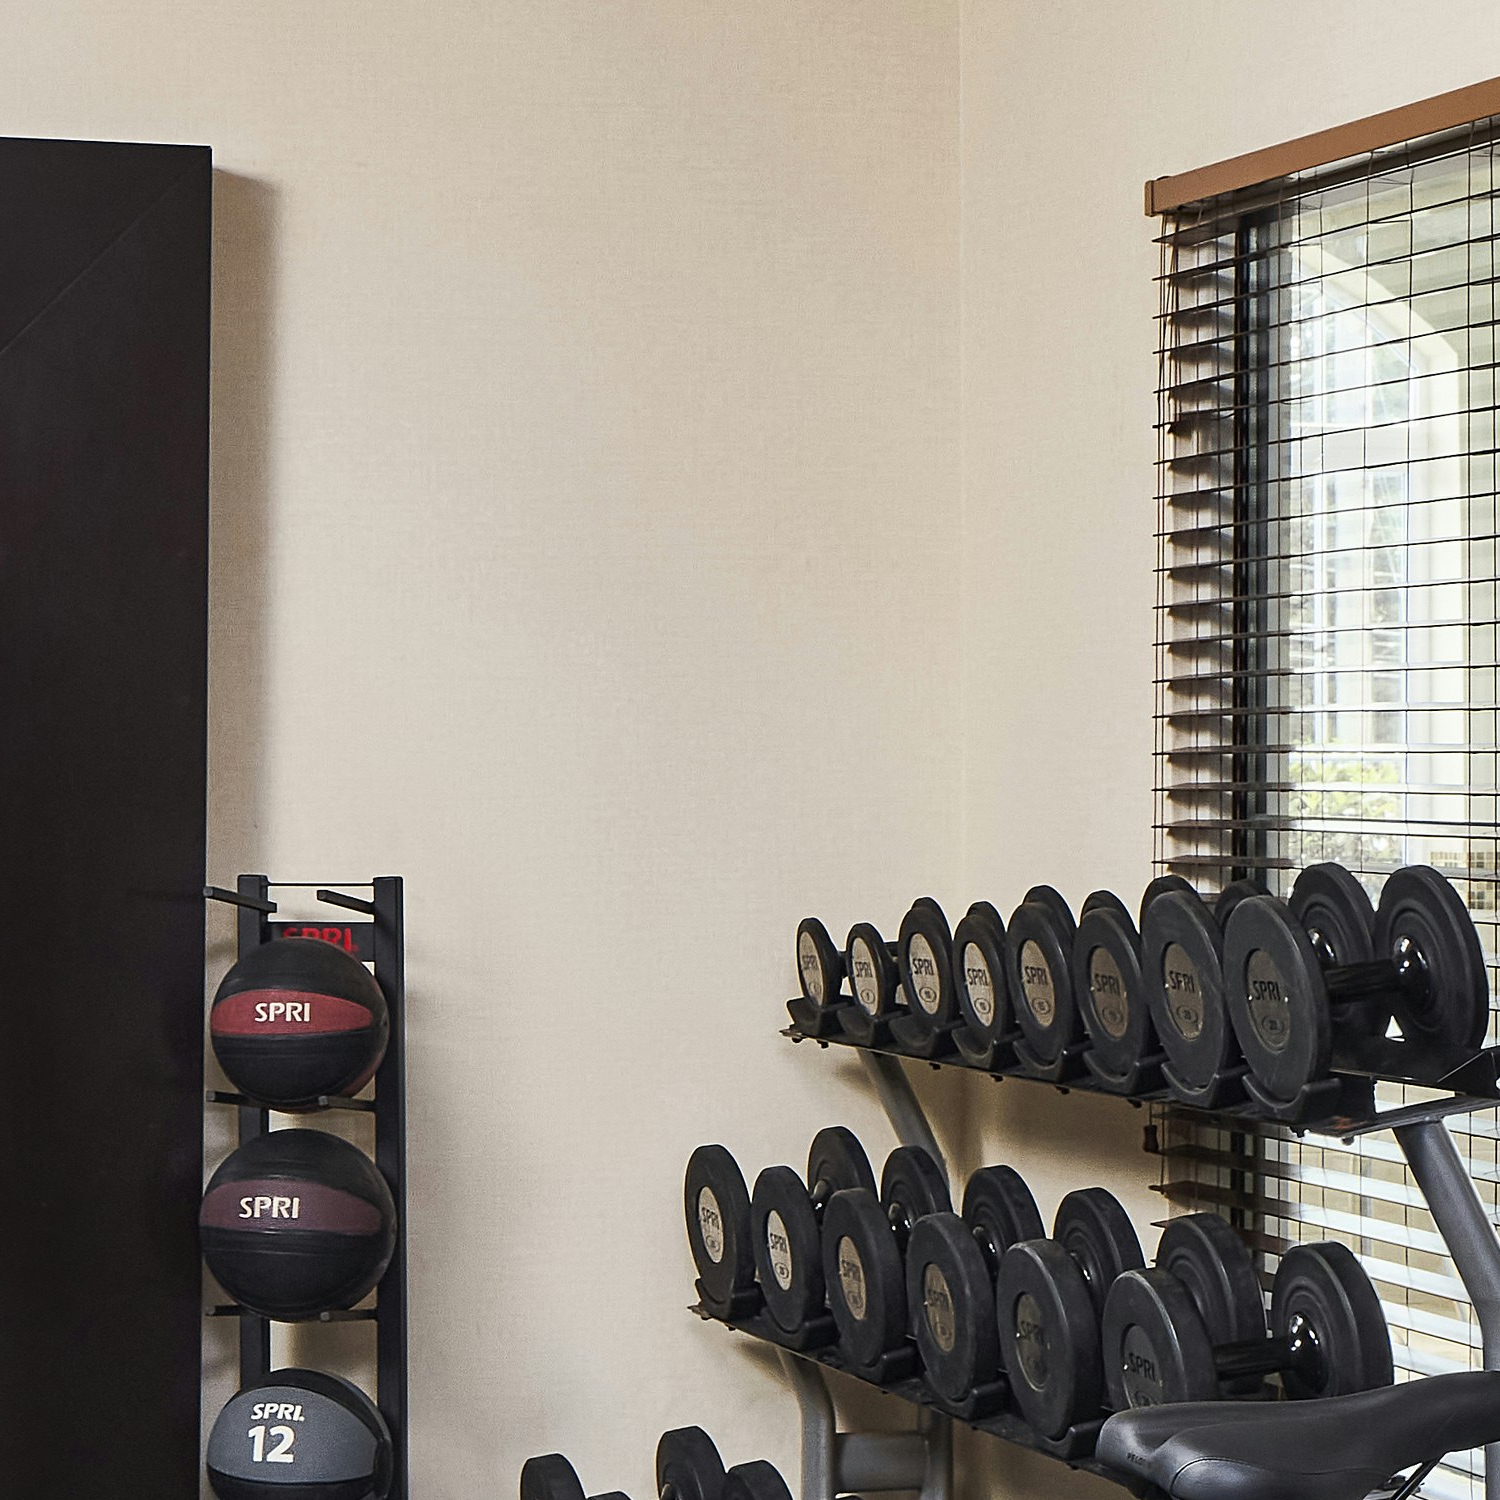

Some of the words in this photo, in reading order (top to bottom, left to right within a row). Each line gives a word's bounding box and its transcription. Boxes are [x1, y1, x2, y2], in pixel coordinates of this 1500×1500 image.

[912, 958, 934, 976] SPRI
[967, 968, 989, 987] SPRI
[1025, 966, 1047, 987] SPRI
[1095, 973, 1120, 996] SPRI
[1253, 981, 1281, 1001] SPRI
[254, 1002, 310, 1022] SPRI
[239, 1196, 300, 1218] SPRI
[1128, 1352, 1156, 1381] SPRI
[248, 1425, 294, 1463] 12
